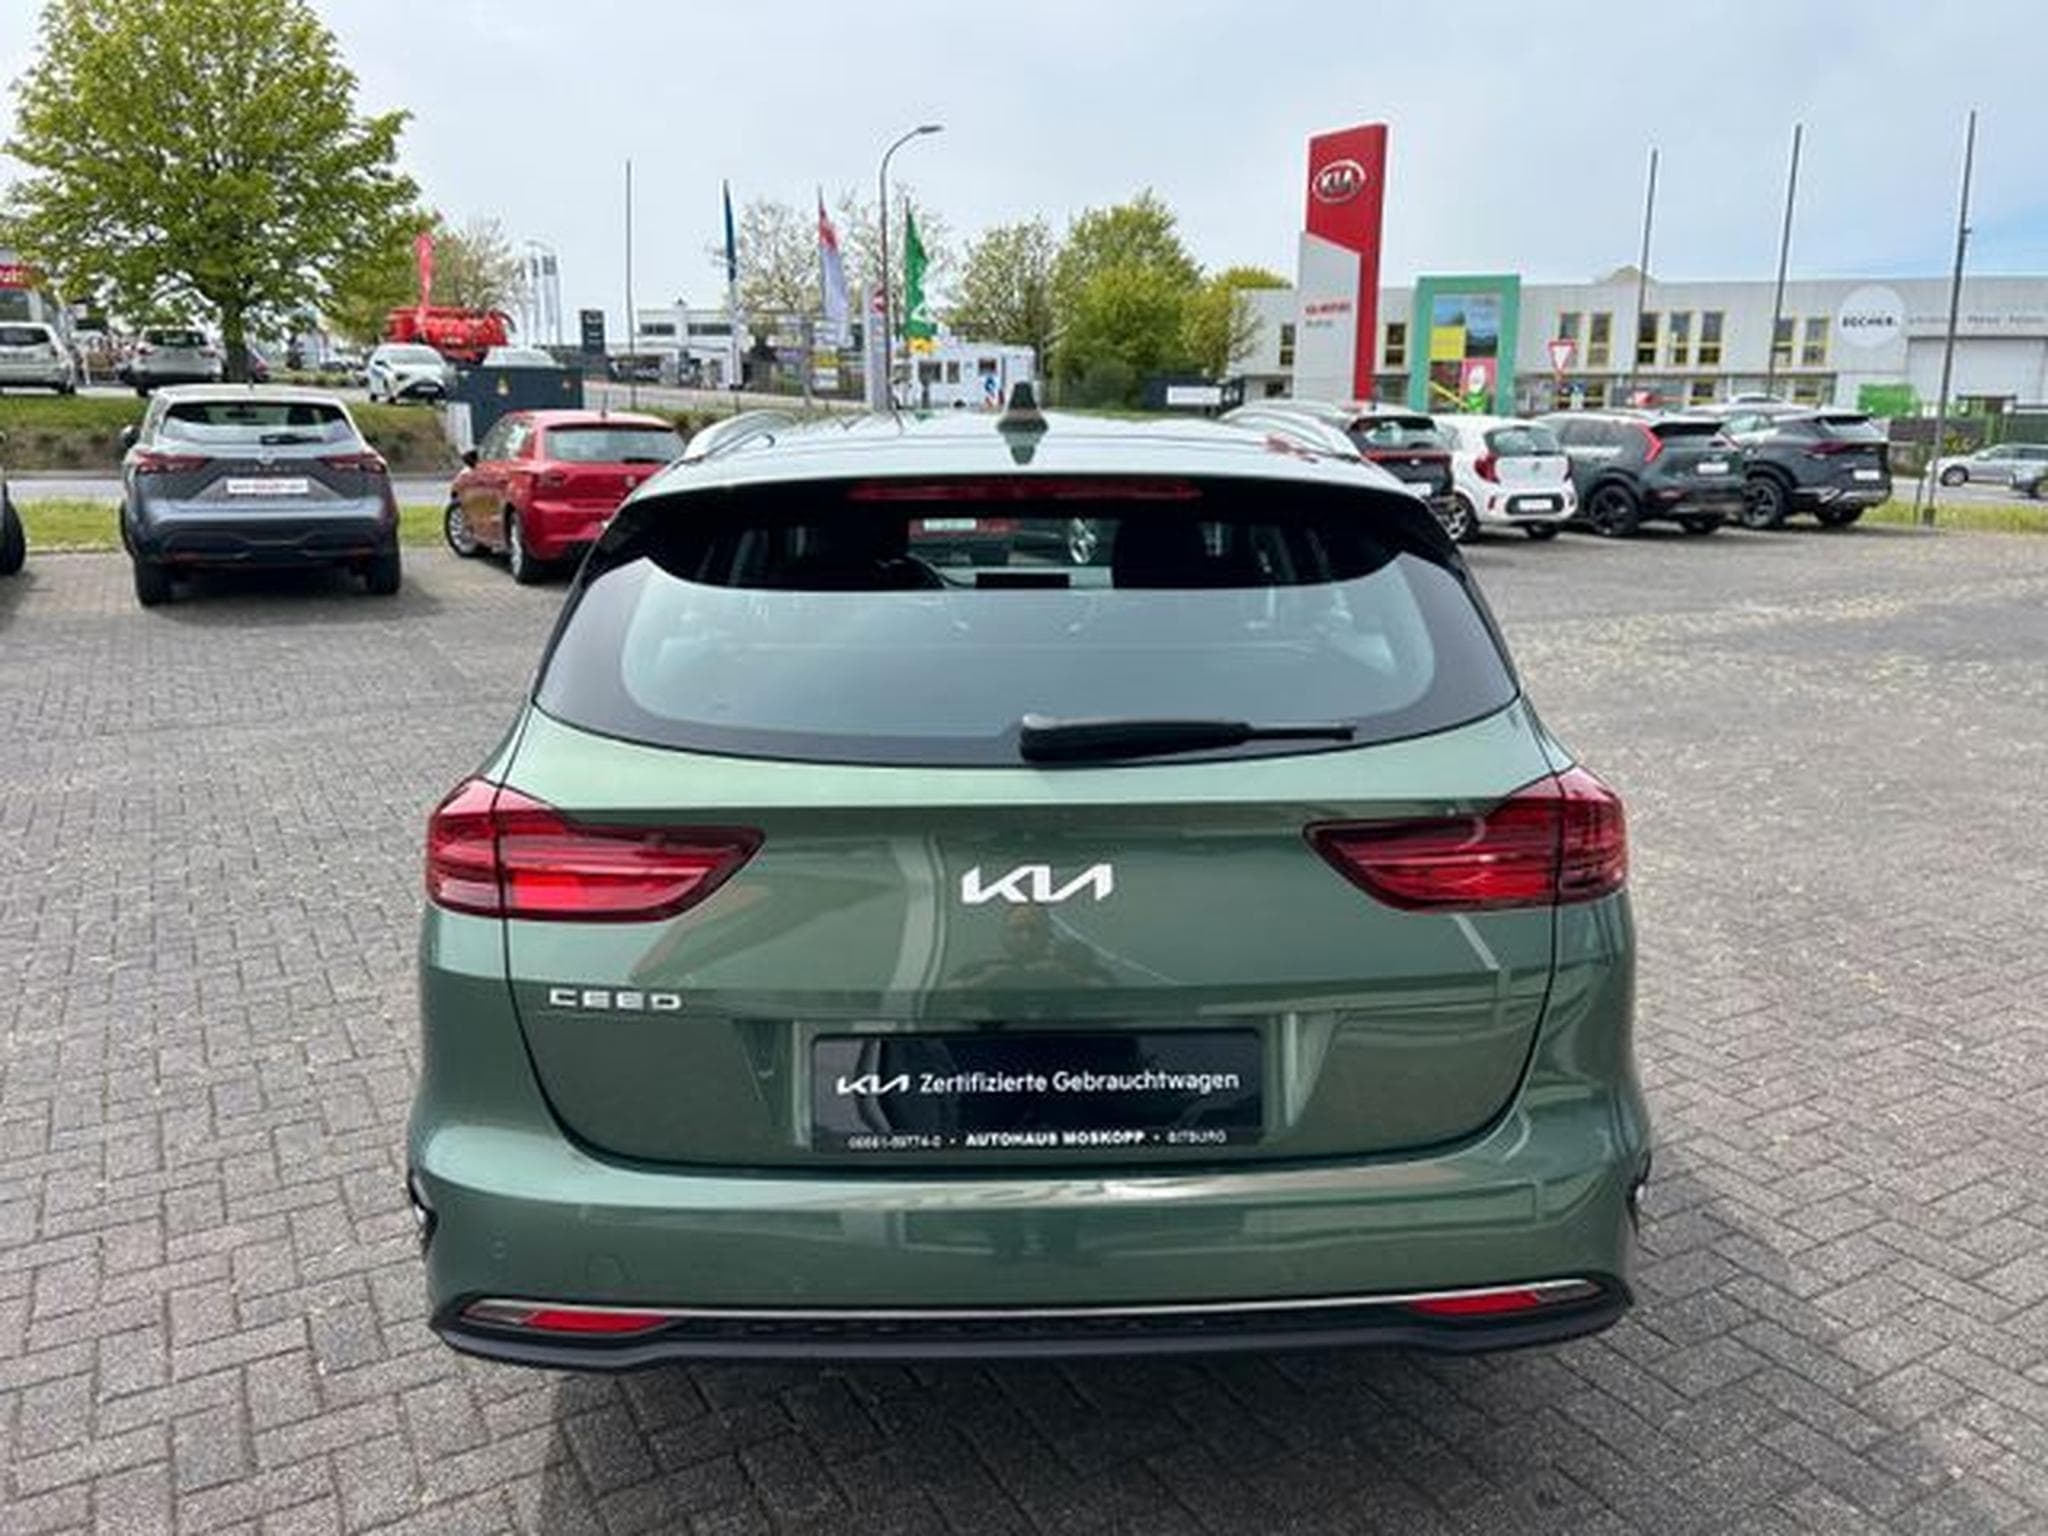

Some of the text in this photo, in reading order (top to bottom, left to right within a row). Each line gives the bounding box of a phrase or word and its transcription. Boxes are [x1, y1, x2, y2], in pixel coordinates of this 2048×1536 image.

[1320, 166, 1357, 193] KIA
[962, 863, 1112, 903] KIA
[550, 988, 681, 1010] CEED
[836, 1070, 1240, 1095] KIA Zertifizierte Gebrauchtwagen
[966, 1131, 1058, 1147] AUTOHAUS
[1062, 1130, 1146, 1146] MOSKOPP
